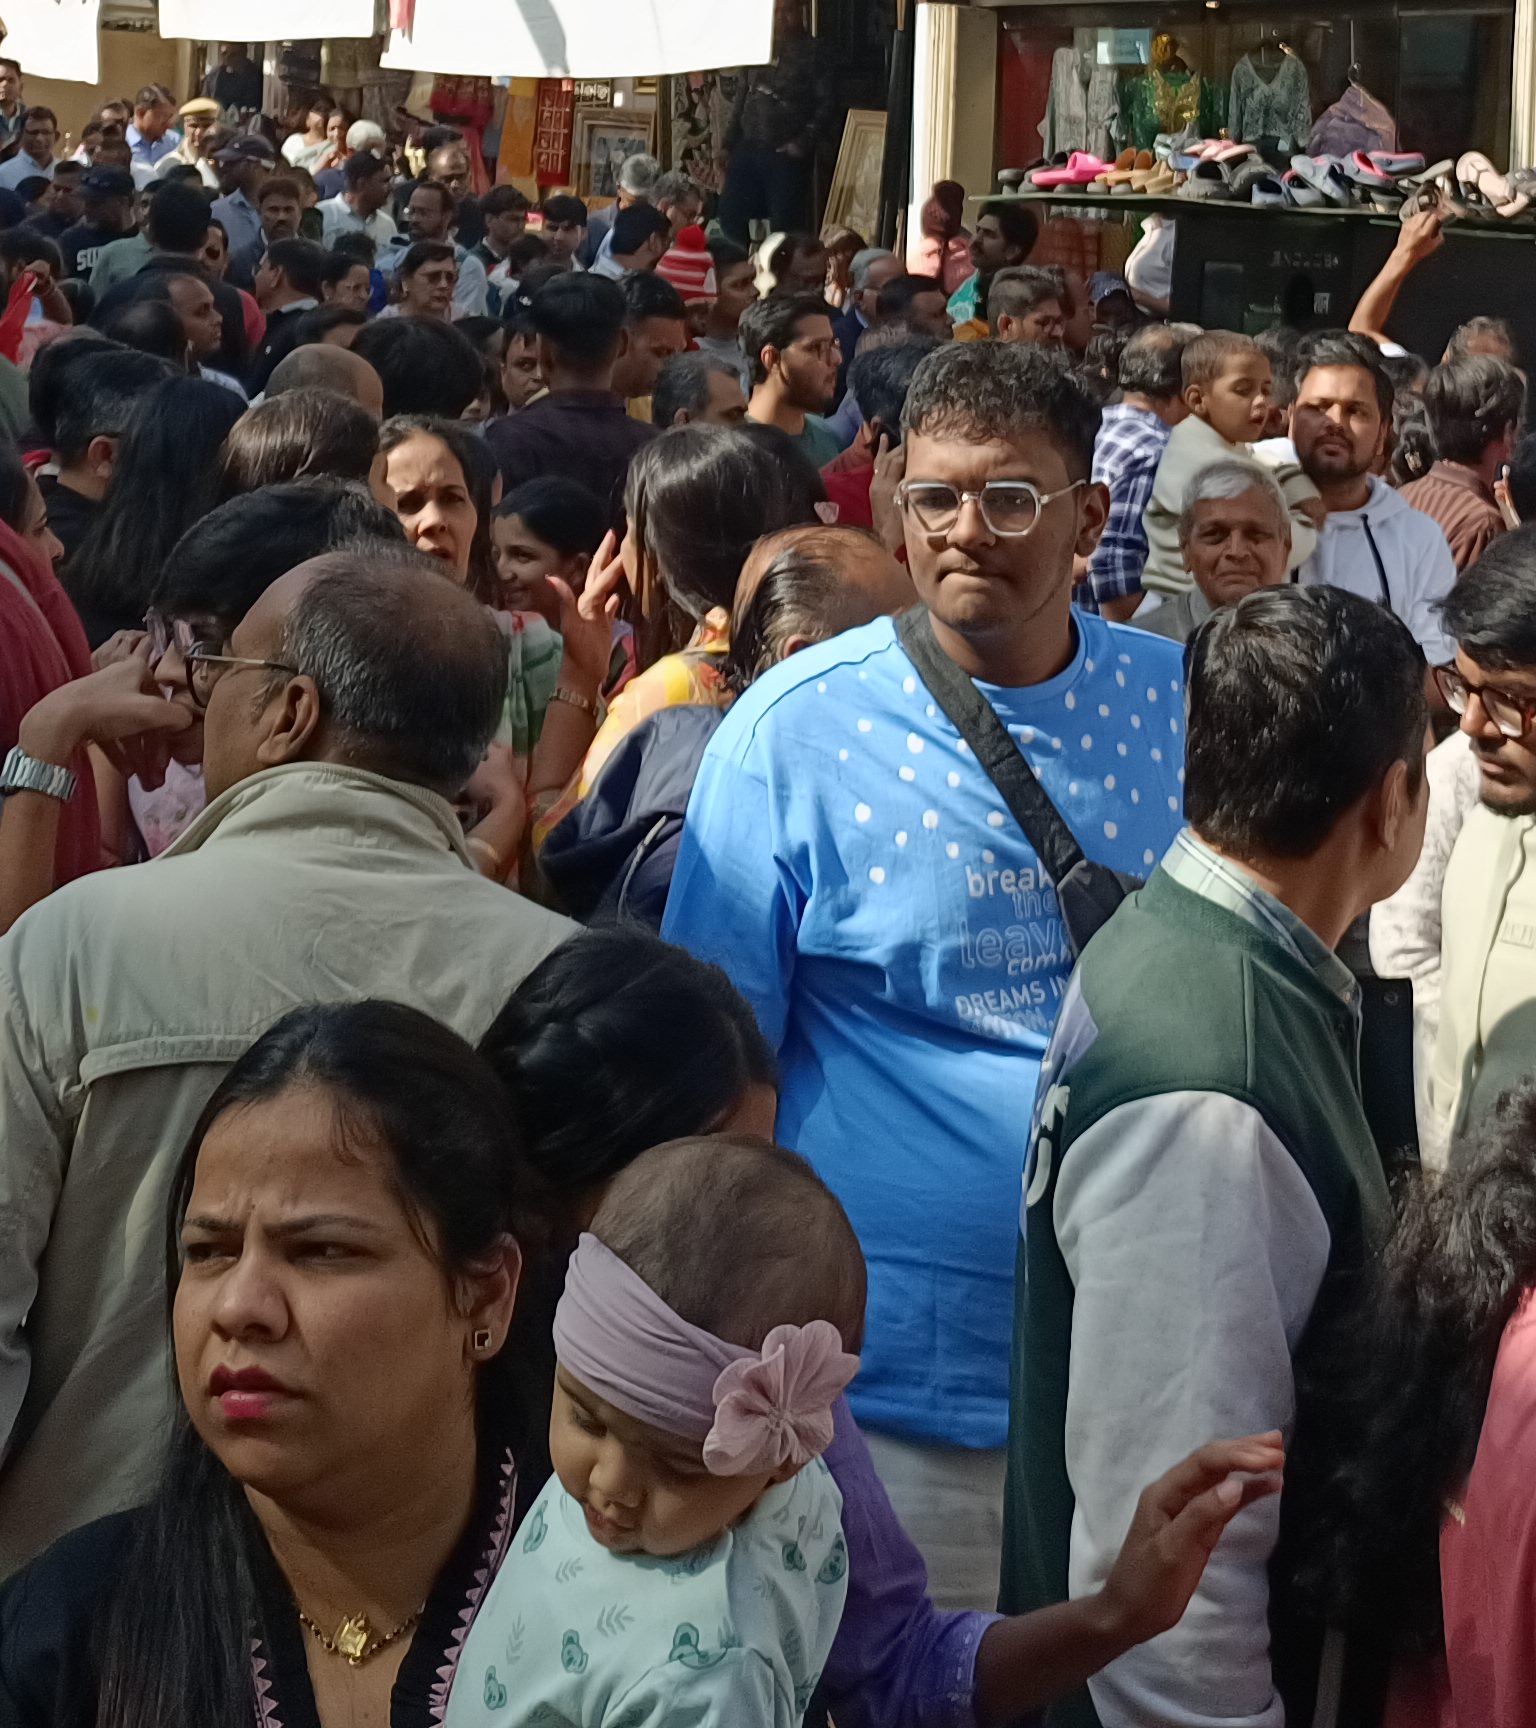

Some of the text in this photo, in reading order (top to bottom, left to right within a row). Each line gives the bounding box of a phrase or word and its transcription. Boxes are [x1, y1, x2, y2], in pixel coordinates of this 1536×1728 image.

[965, 856, 1056, 898] break
[958, 917, 1073, 970] leav
[954, 980, 1047, 1021] DREAMS
